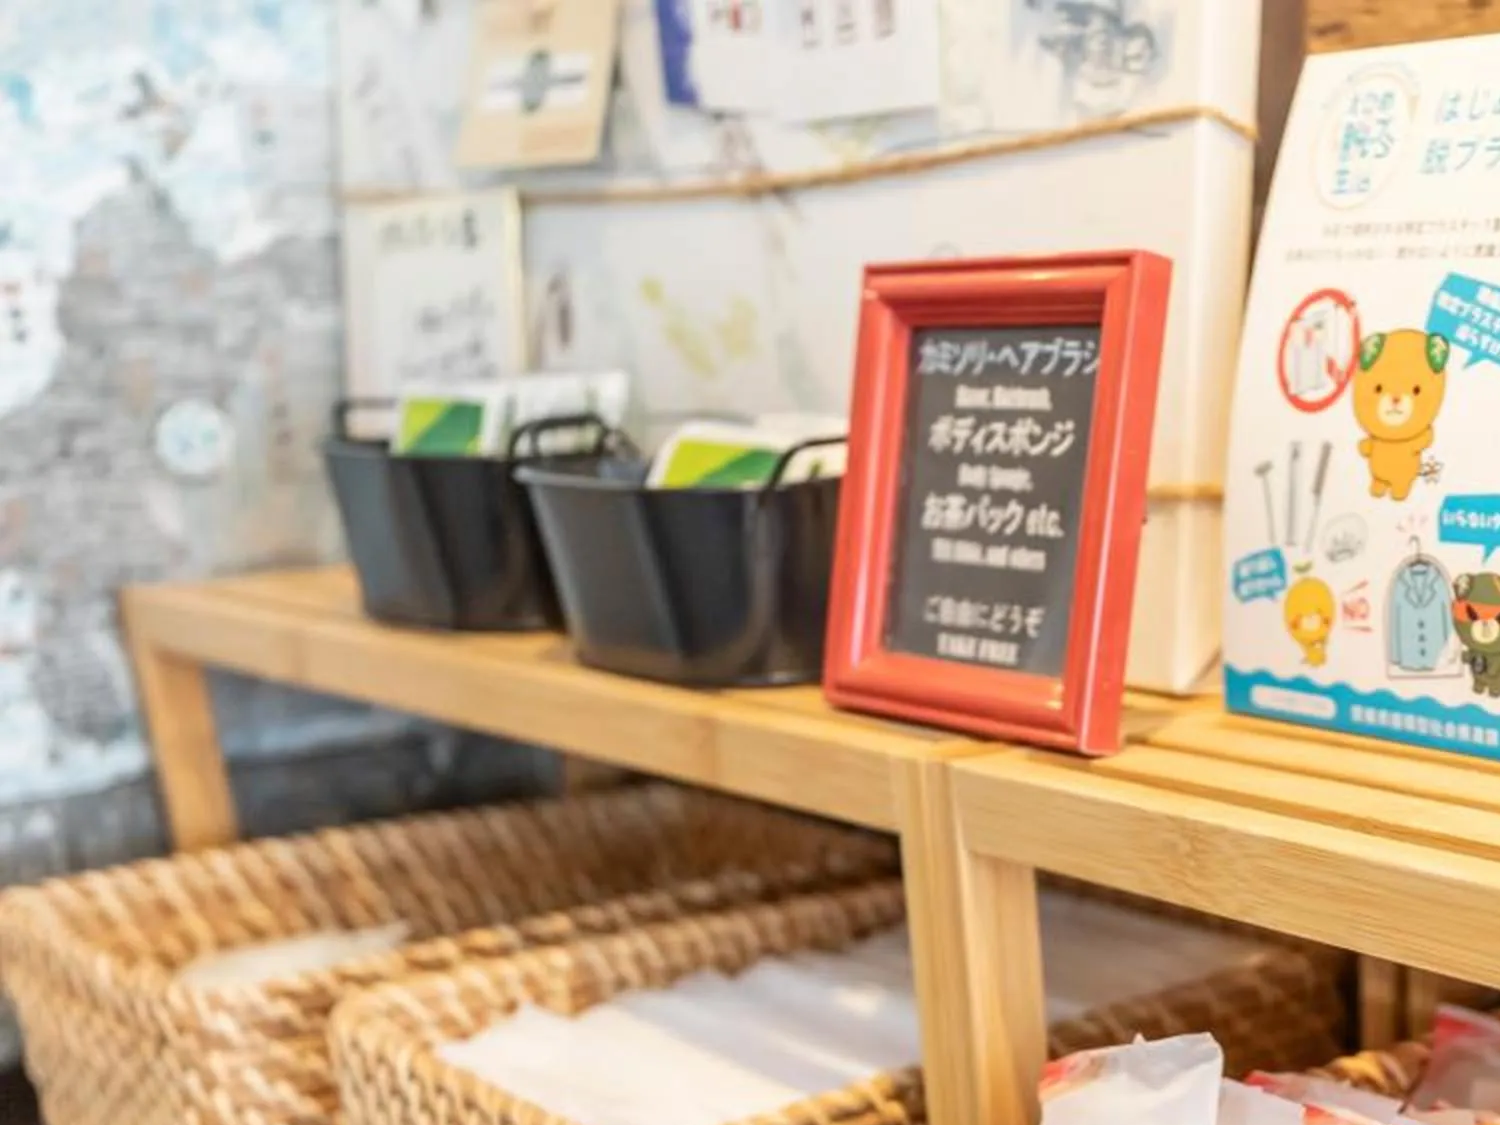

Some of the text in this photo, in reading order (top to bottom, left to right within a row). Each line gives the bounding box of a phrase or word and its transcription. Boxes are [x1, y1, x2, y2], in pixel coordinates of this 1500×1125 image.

[928, 415, 1076, 458] ボディスポンジ
